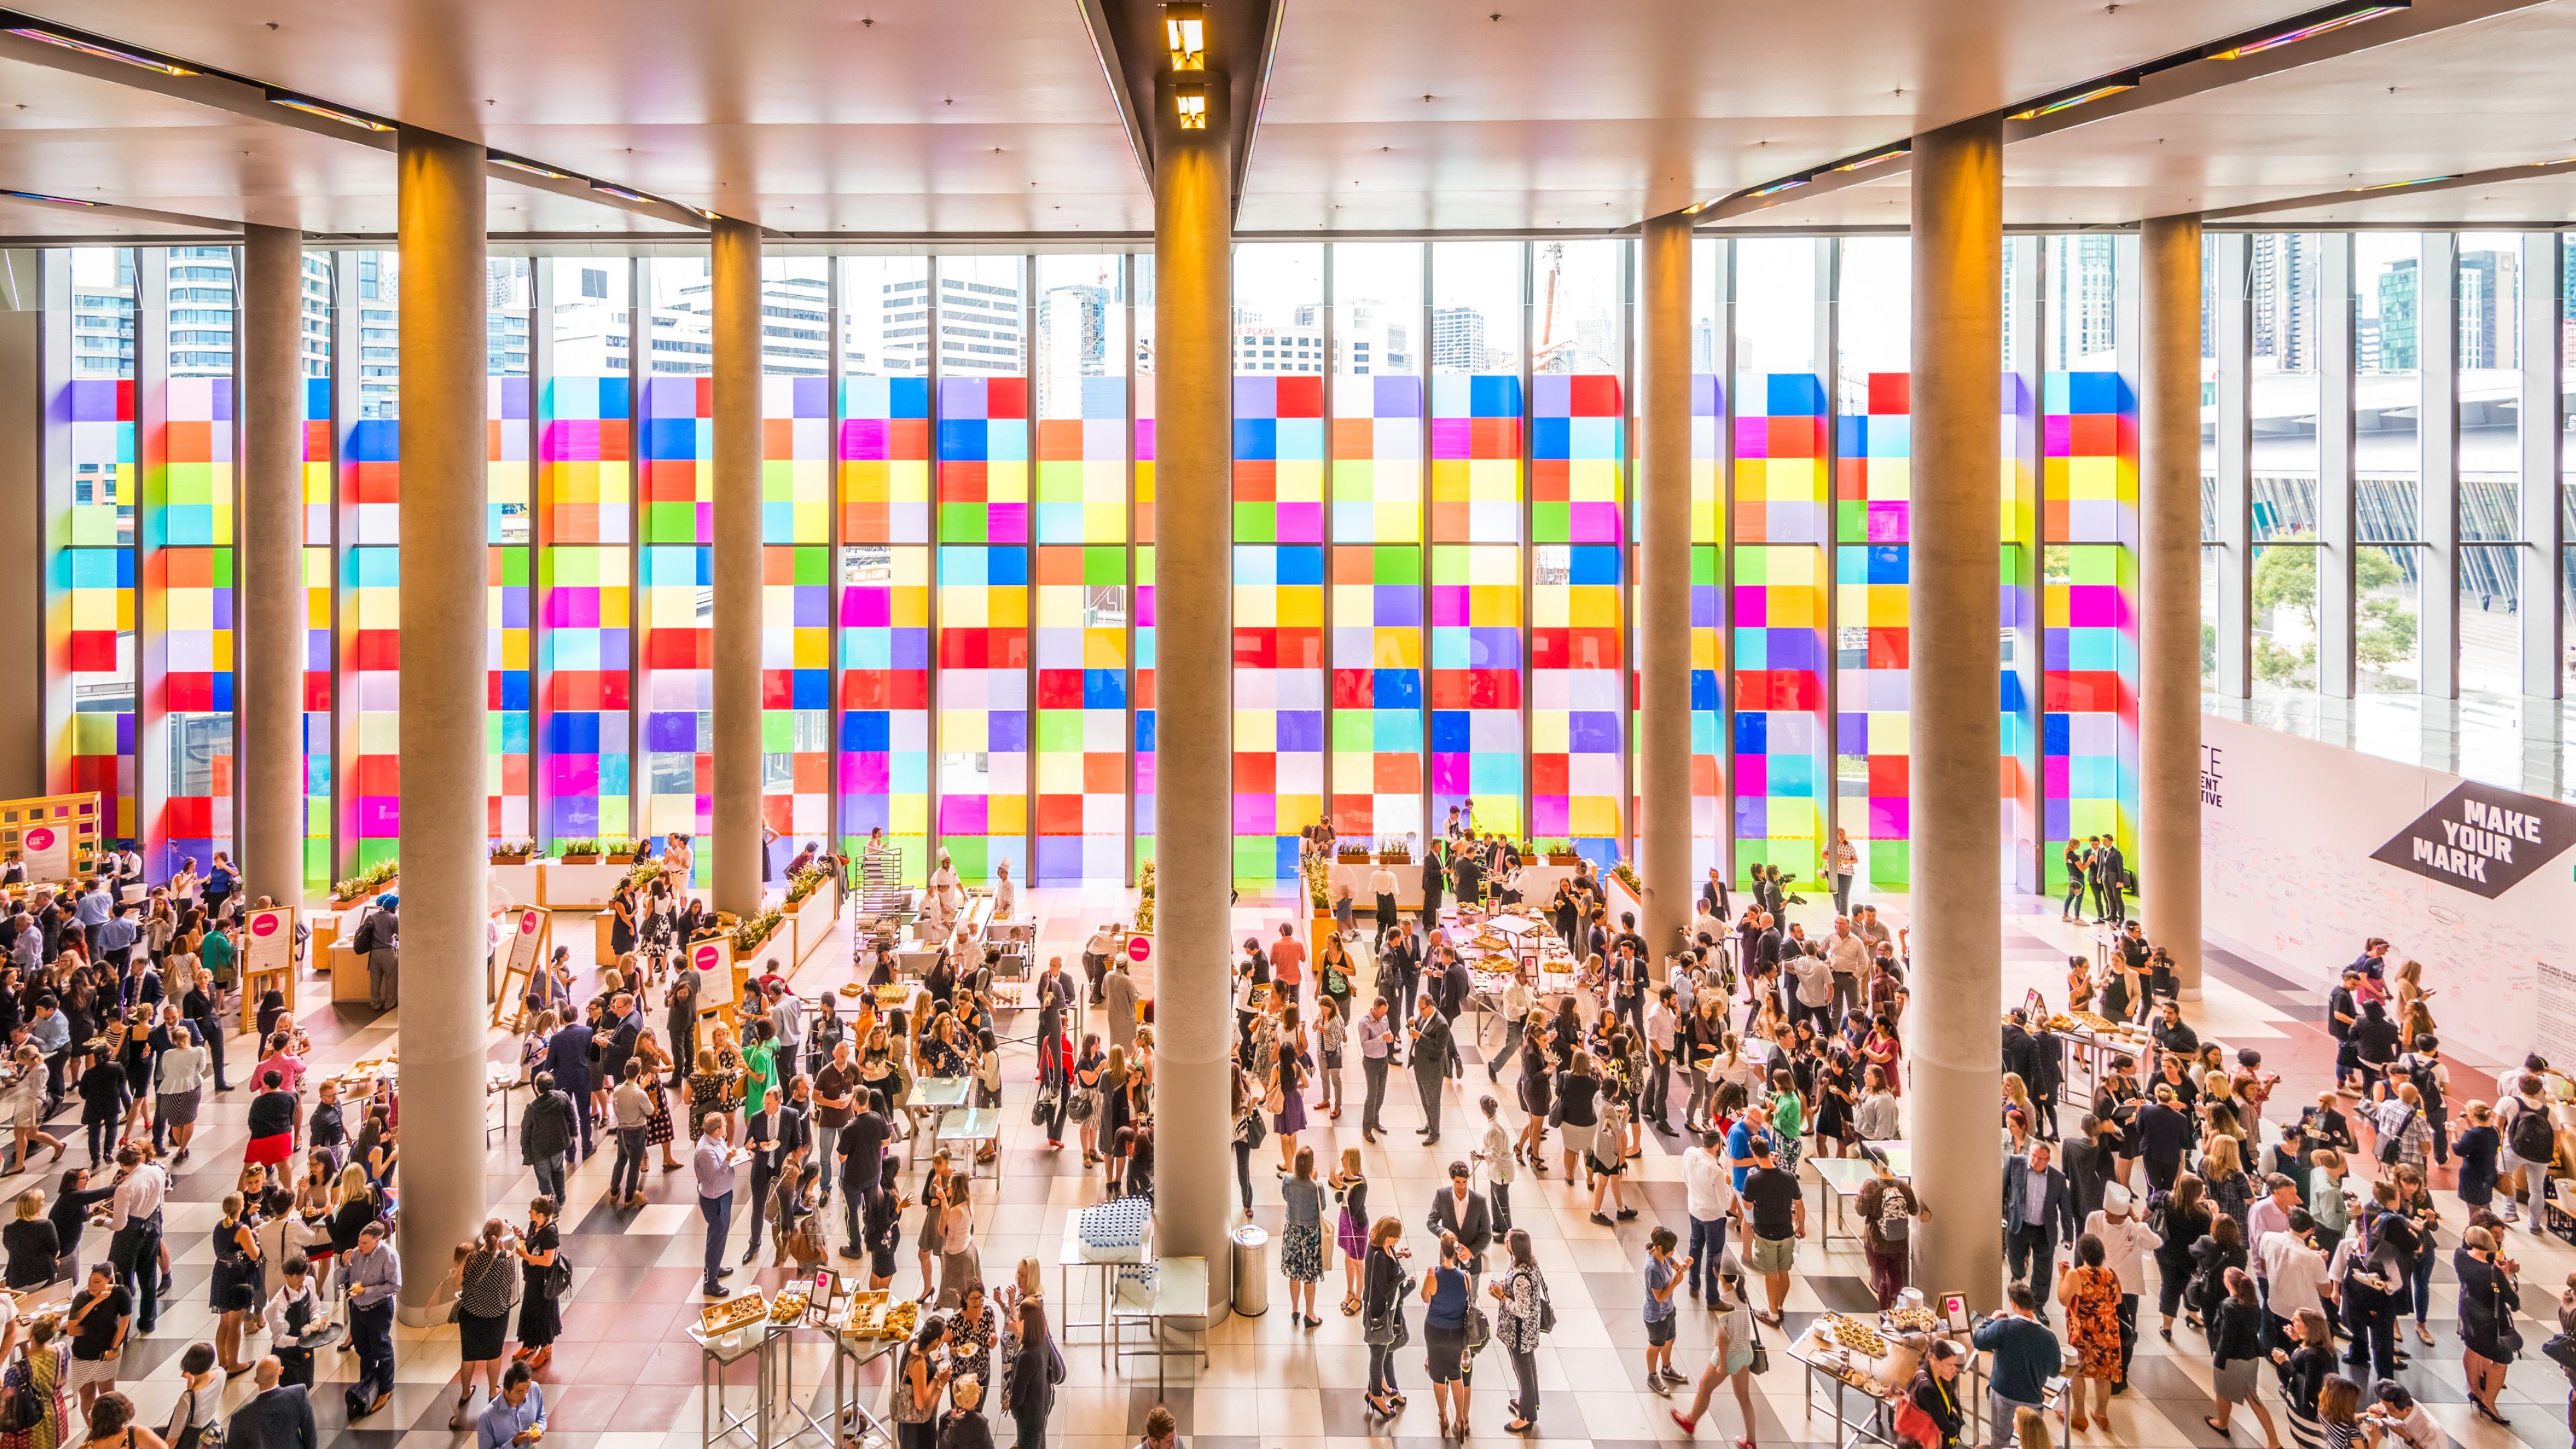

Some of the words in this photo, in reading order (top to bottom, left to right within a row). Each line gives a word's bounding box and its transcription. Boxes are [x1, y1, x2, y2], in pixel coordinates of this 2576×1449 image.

[1246, 327, 1275, 335] PLAZA
[854, 570, 867, 580] BAR
[872, 570, 886, 579] CAFE
[2201, 789, 2222, 808] TIVE
[2464, 799, 2541, 844] MAKE
[2442, 818, 2513, 864] YOUR
[2413, 836, 2486, 883] MARK
[2540, 967, 2562, 978] DIFFERENT
[2548, 965, 2561, 973] SPACE
